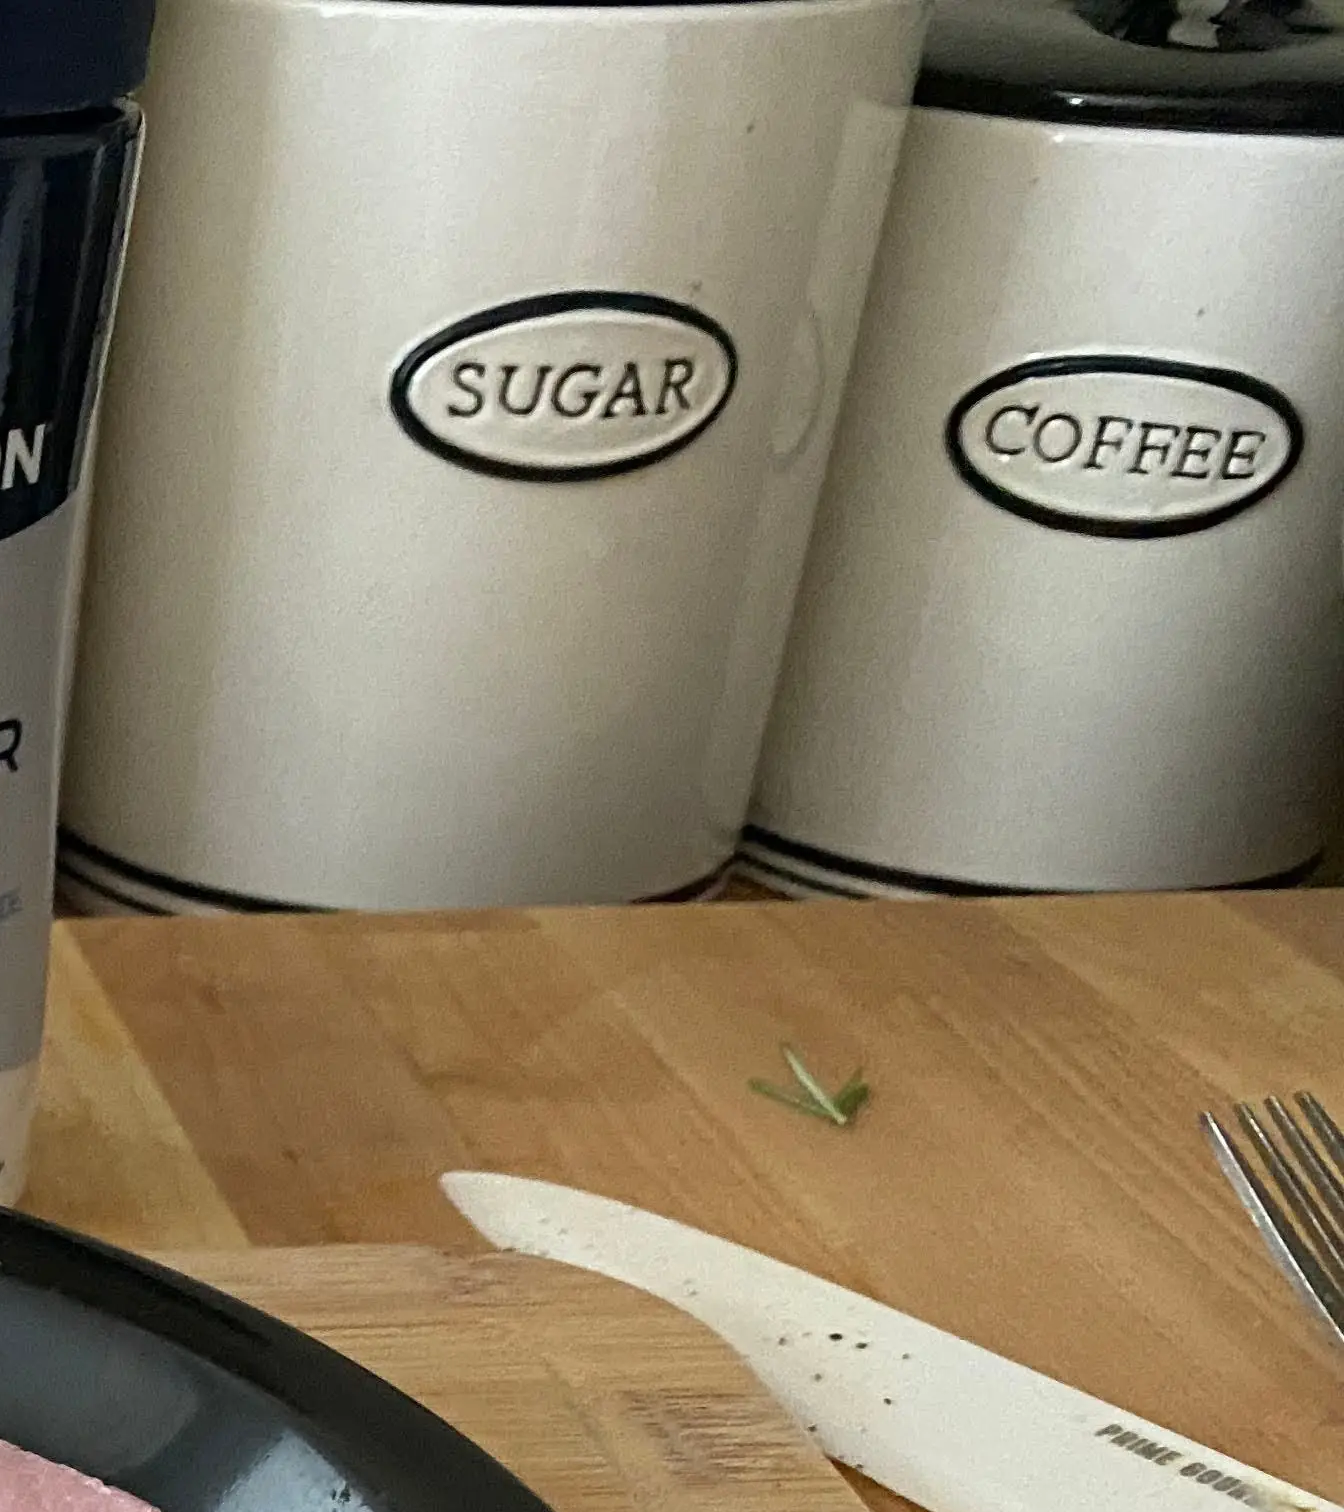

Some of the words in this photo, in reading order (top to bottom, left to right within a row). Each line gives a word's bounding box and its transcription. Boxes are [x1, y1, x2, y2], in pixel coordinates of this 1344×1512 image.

[448, 357, 693, 418] SUGAR
[985, 405, 1265, 479] COFFEE
[1095, 1423, 1183, 1466] PRIME
